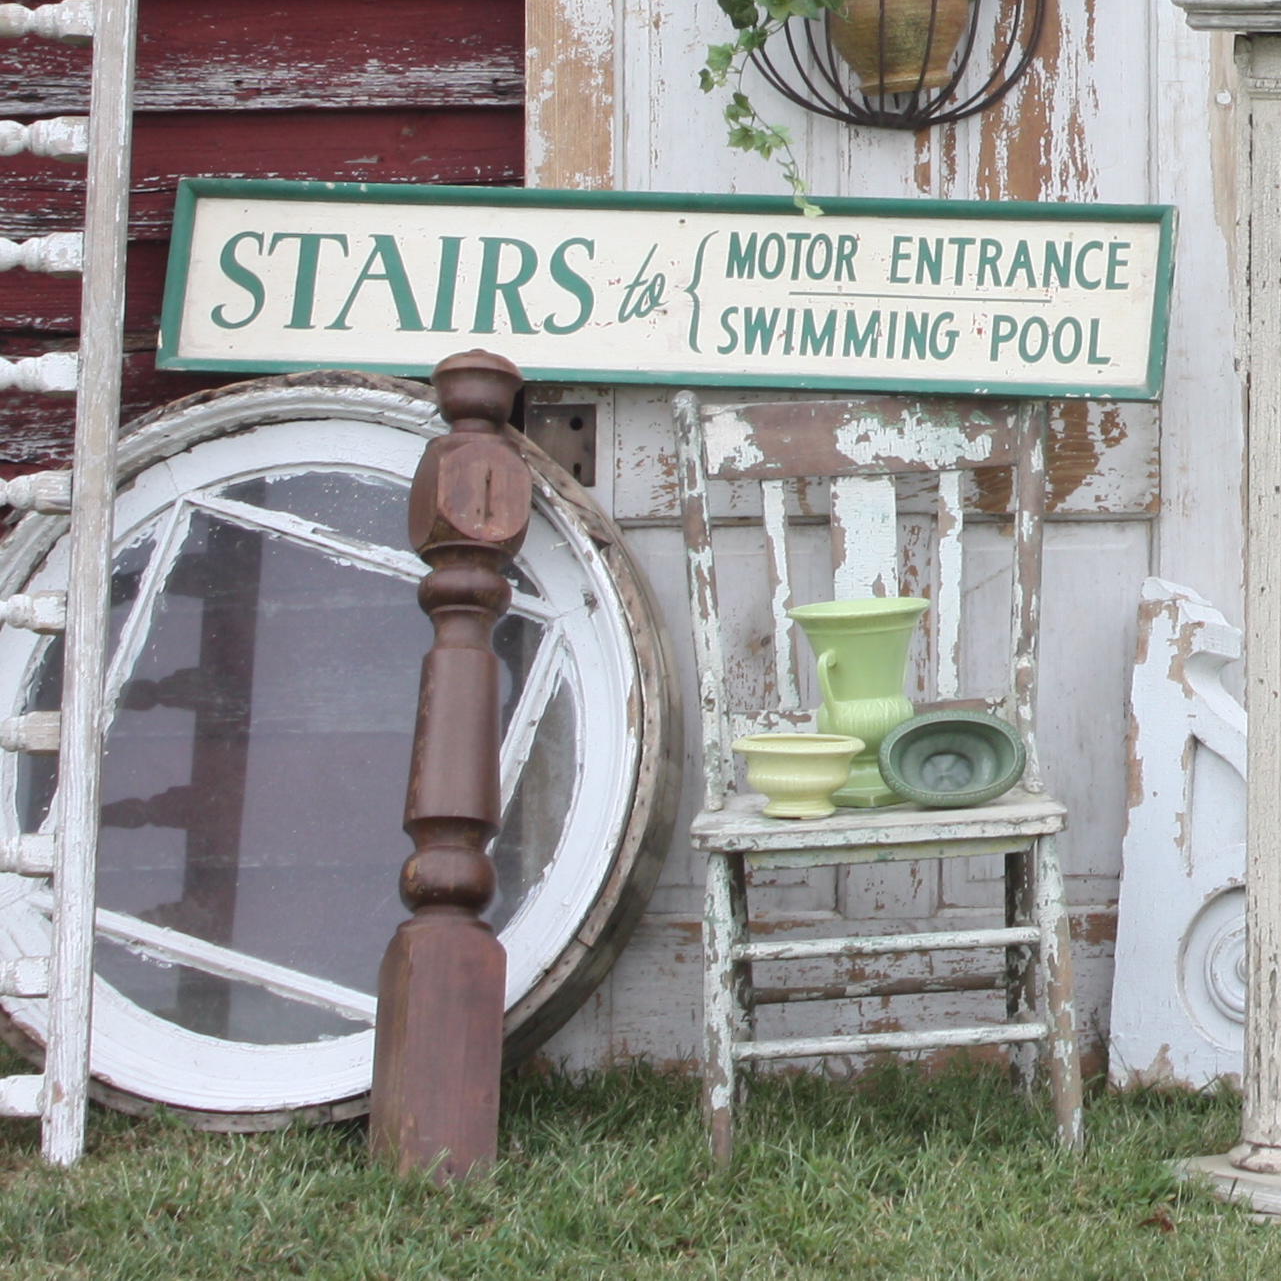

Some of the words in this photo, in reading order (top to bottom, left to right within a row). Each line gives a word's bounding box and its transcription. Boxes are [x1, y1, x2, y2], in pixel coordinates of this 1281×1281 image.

[209, 229, 597, 337] STAIRS
[615, 240, 668, 326] to
[725, 230, 859, 284] MOTOR
[889, 235, 1131, 292] ENTRANCE
[716, 305, 961, 362] SWIMMING
[989, 314, 1112, 367] POOL
